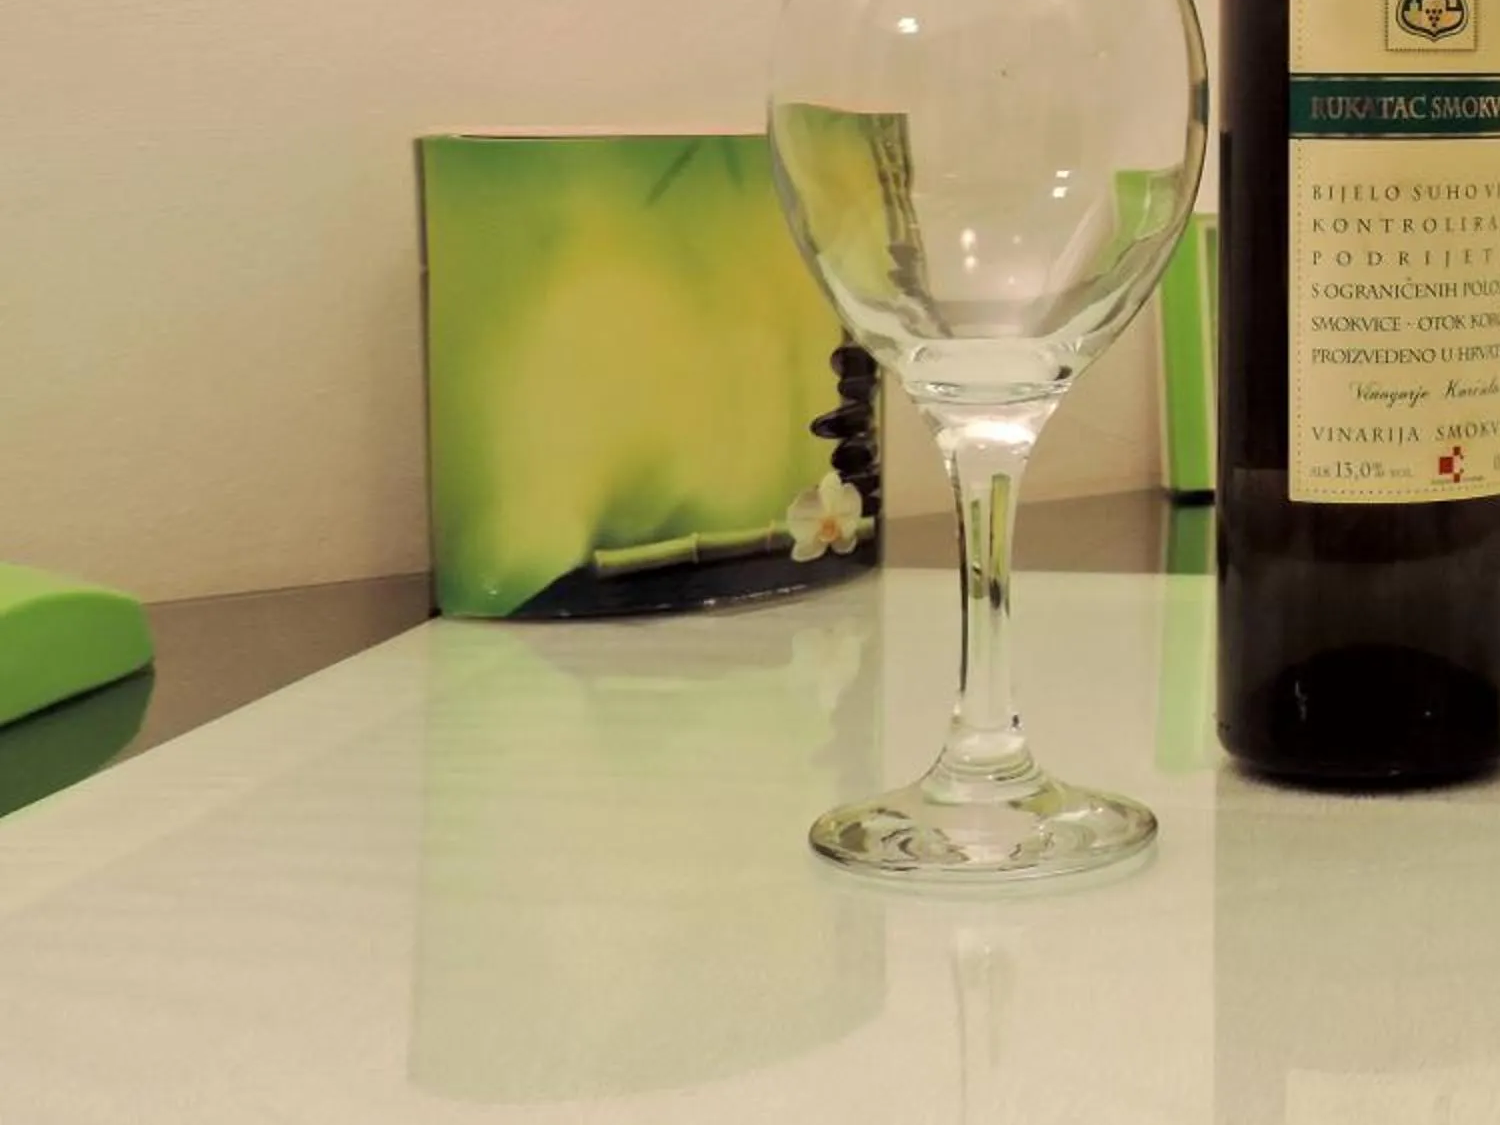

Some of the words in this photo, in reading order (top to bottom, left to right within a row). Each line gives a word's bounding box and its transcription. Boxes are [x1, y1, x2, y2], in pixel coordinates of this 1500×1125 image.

[1311, 95, 1427, 120] RUKATAC
[1312, 184, 1400, 203] BIJELO
[1412, 183, 1478, 201] SUHO
[1323, 275, 1458, 300] OGRANIČENIH
[1311, 313, 1402, 332] SMOKVICE
[1417, 313, 1467, 330] OTOK
[1311, 347, 1437, 365] PROIZVEDENO
[1441, 347, 1454, 362] U
[1311, 426, 1421, 445] VINARIJA
